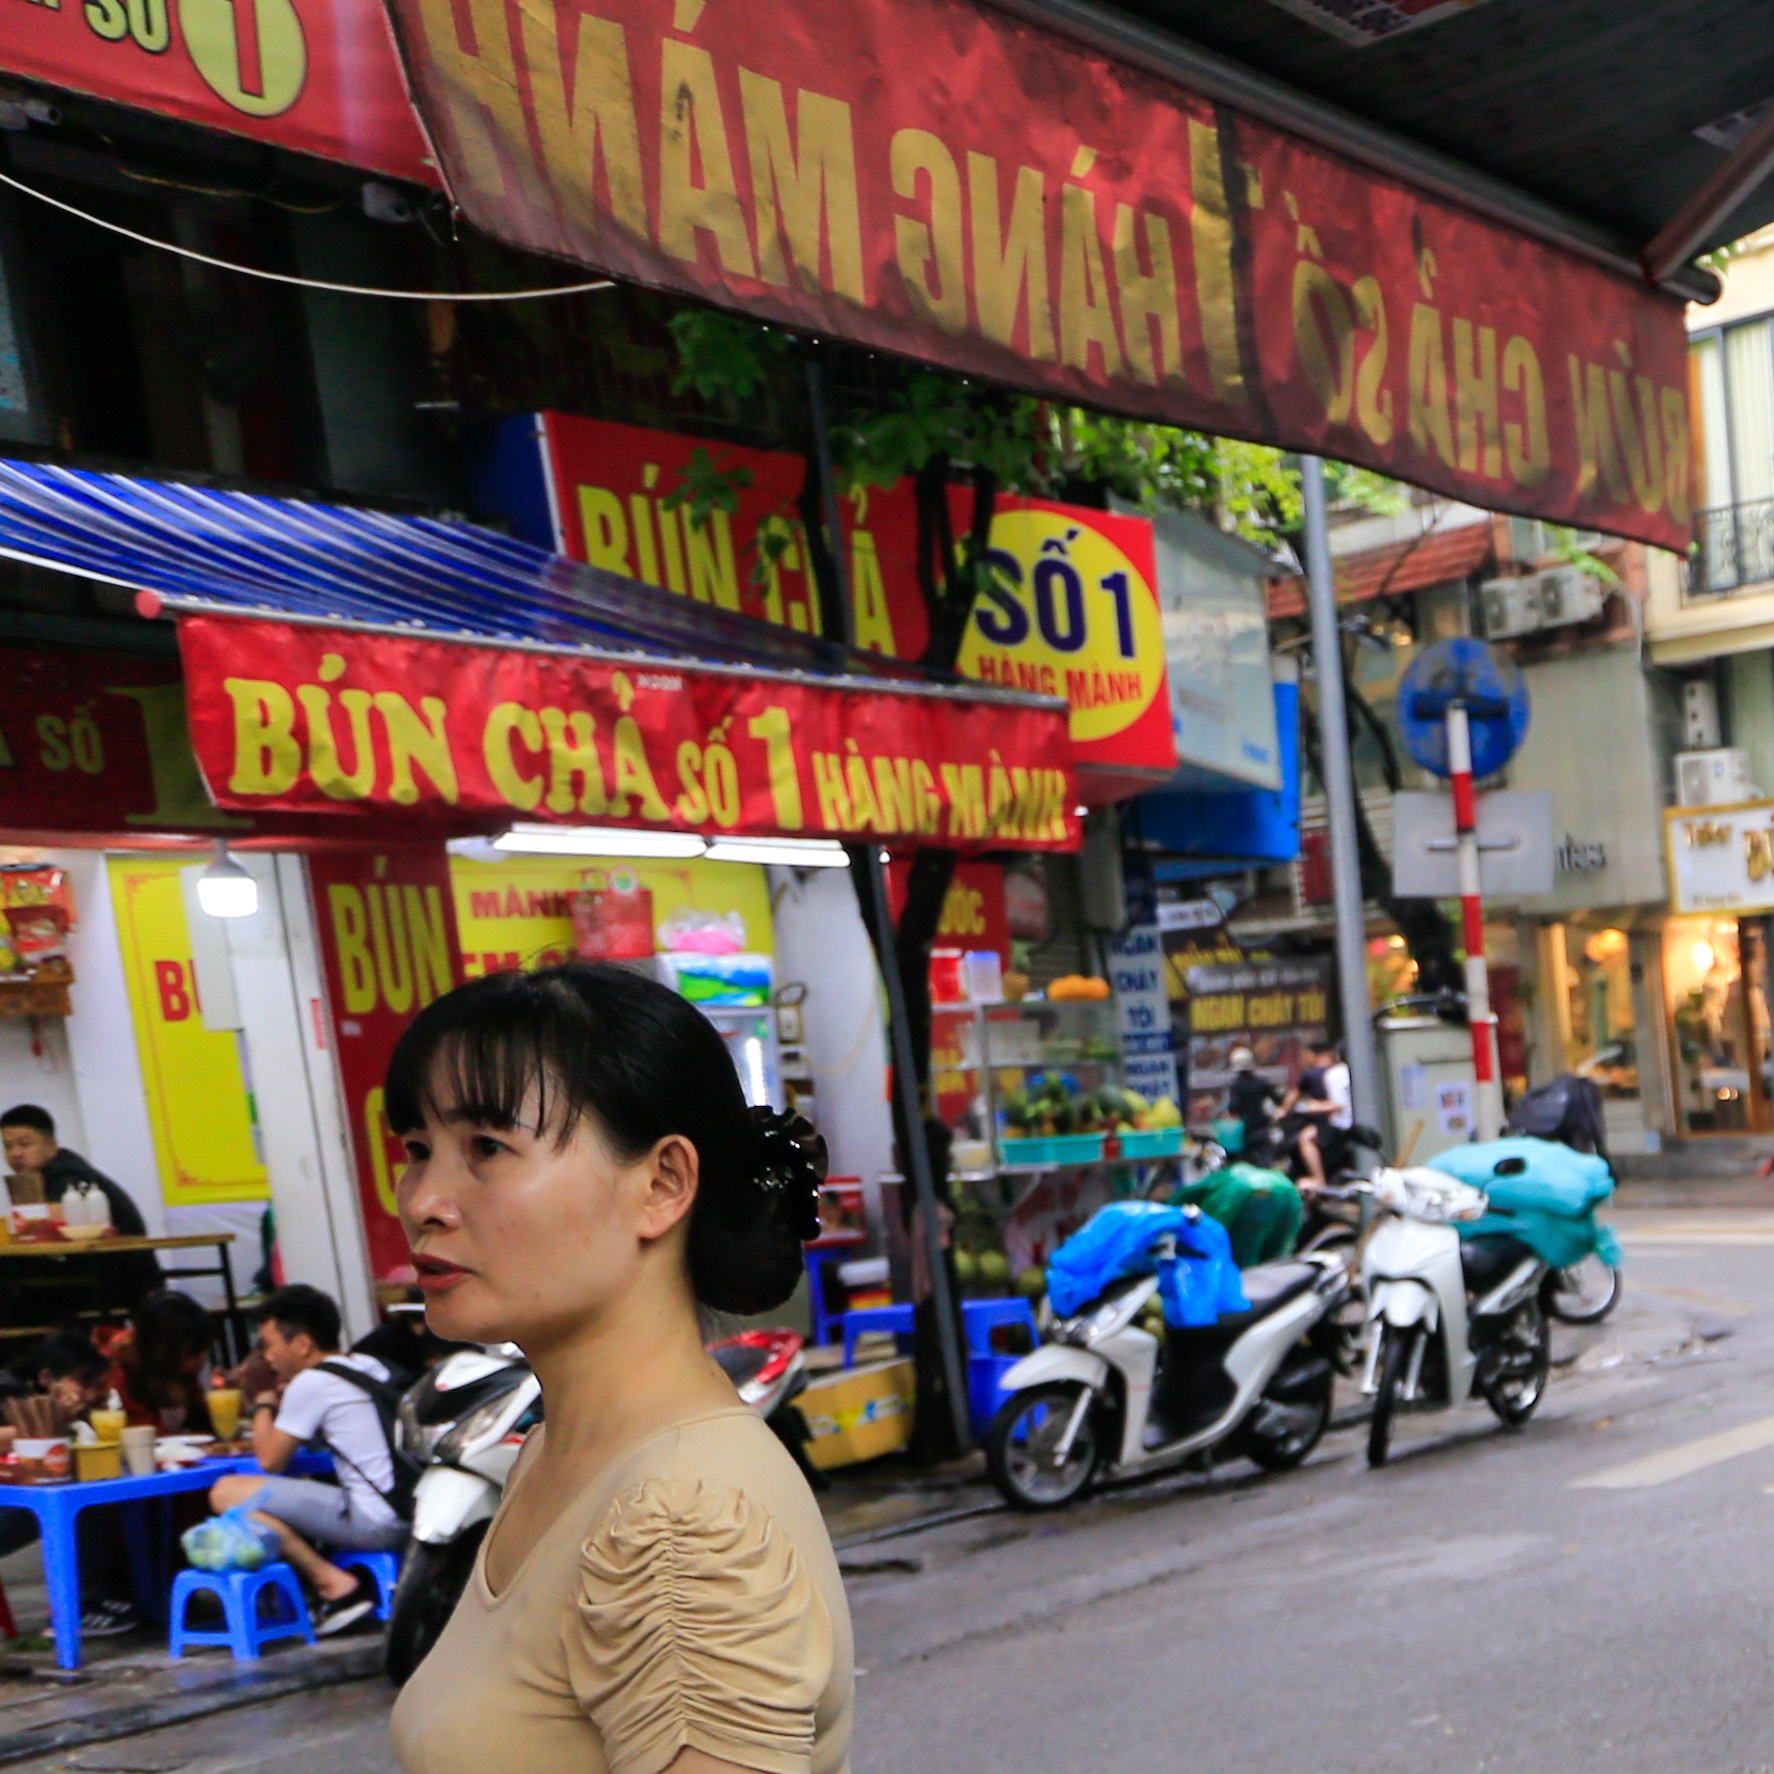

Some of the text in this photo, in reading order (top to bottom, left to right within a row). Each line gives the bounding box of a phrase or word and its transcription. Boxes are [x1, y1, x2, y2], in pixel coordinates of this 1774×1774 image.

[577, 463, 741, 613] BÚN
[974, 528, 1135, 659] SỐ 1
[223, 653, 1068, 841] BÚN CHẢ SỐ 1 HÀNG MÀNH
[978, 649, 1058, 697] HÀNG
[1063, 662, 1143, 711] MÀNH
[328, 855, 457, 1014] BÚN
